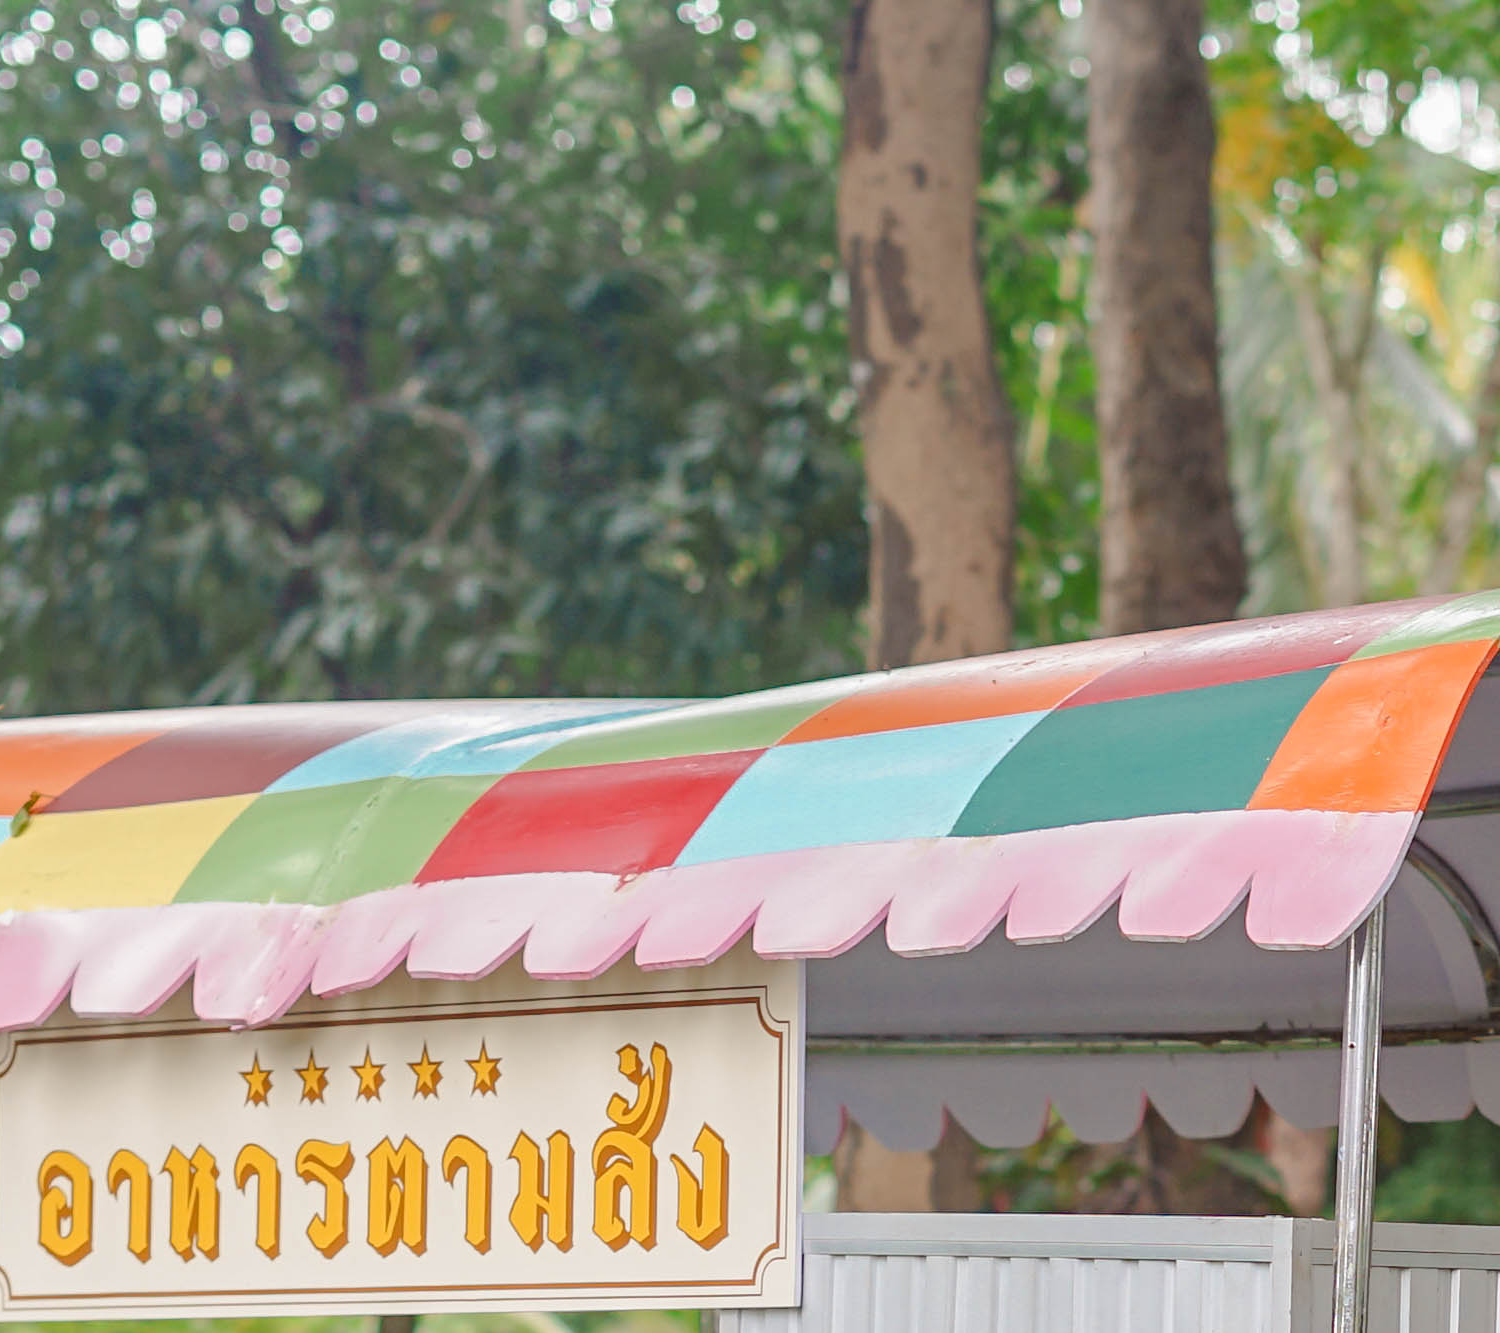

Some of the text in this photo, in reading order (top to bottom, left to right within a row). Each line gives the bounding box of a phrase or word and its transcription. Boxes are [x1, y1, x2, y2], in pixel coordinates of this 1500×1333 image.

[37, 1042, 729, 1266] อาหารตามสั่ง
